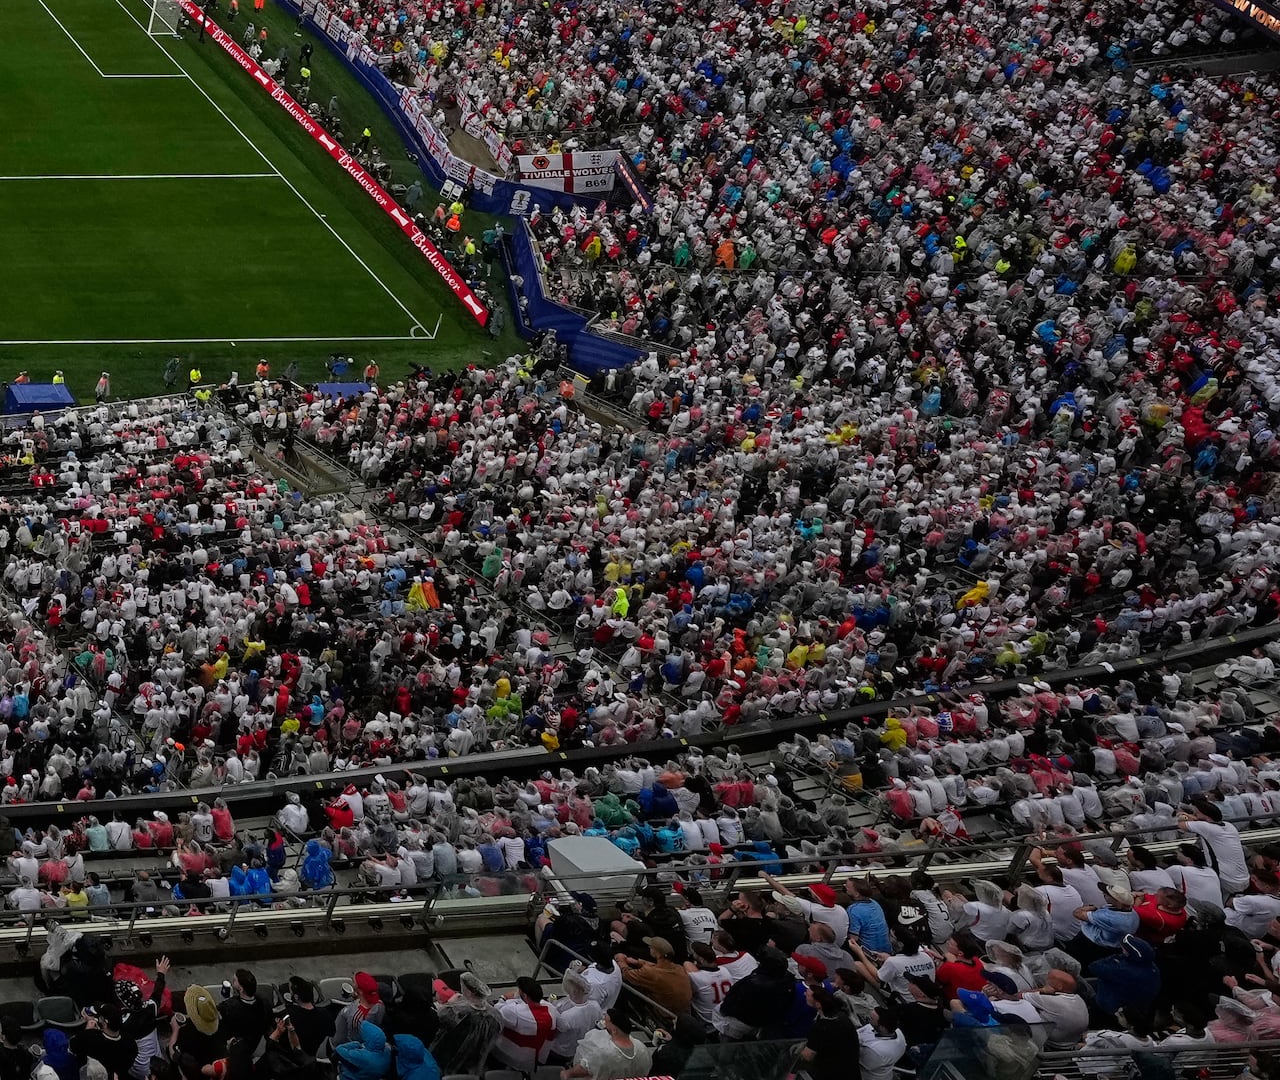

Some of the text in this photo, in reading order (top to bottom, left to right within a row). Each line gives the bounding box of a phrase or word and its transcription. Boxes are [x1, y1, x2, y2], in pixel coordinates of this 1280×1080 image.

[212, 24, 252, 71] Budweiser
[271, 82, 315, 133] Budweiser
[338, 147, 387, 206] Budweiser
[523, 167, 614, 179] TIVIDALE WOLVES
[585, 179, 607, 188] B69
[411, 225, 461, 291] Budweiser
[1261, 799, 1270, 813] 9
[202, 825, 210, 835] 10
